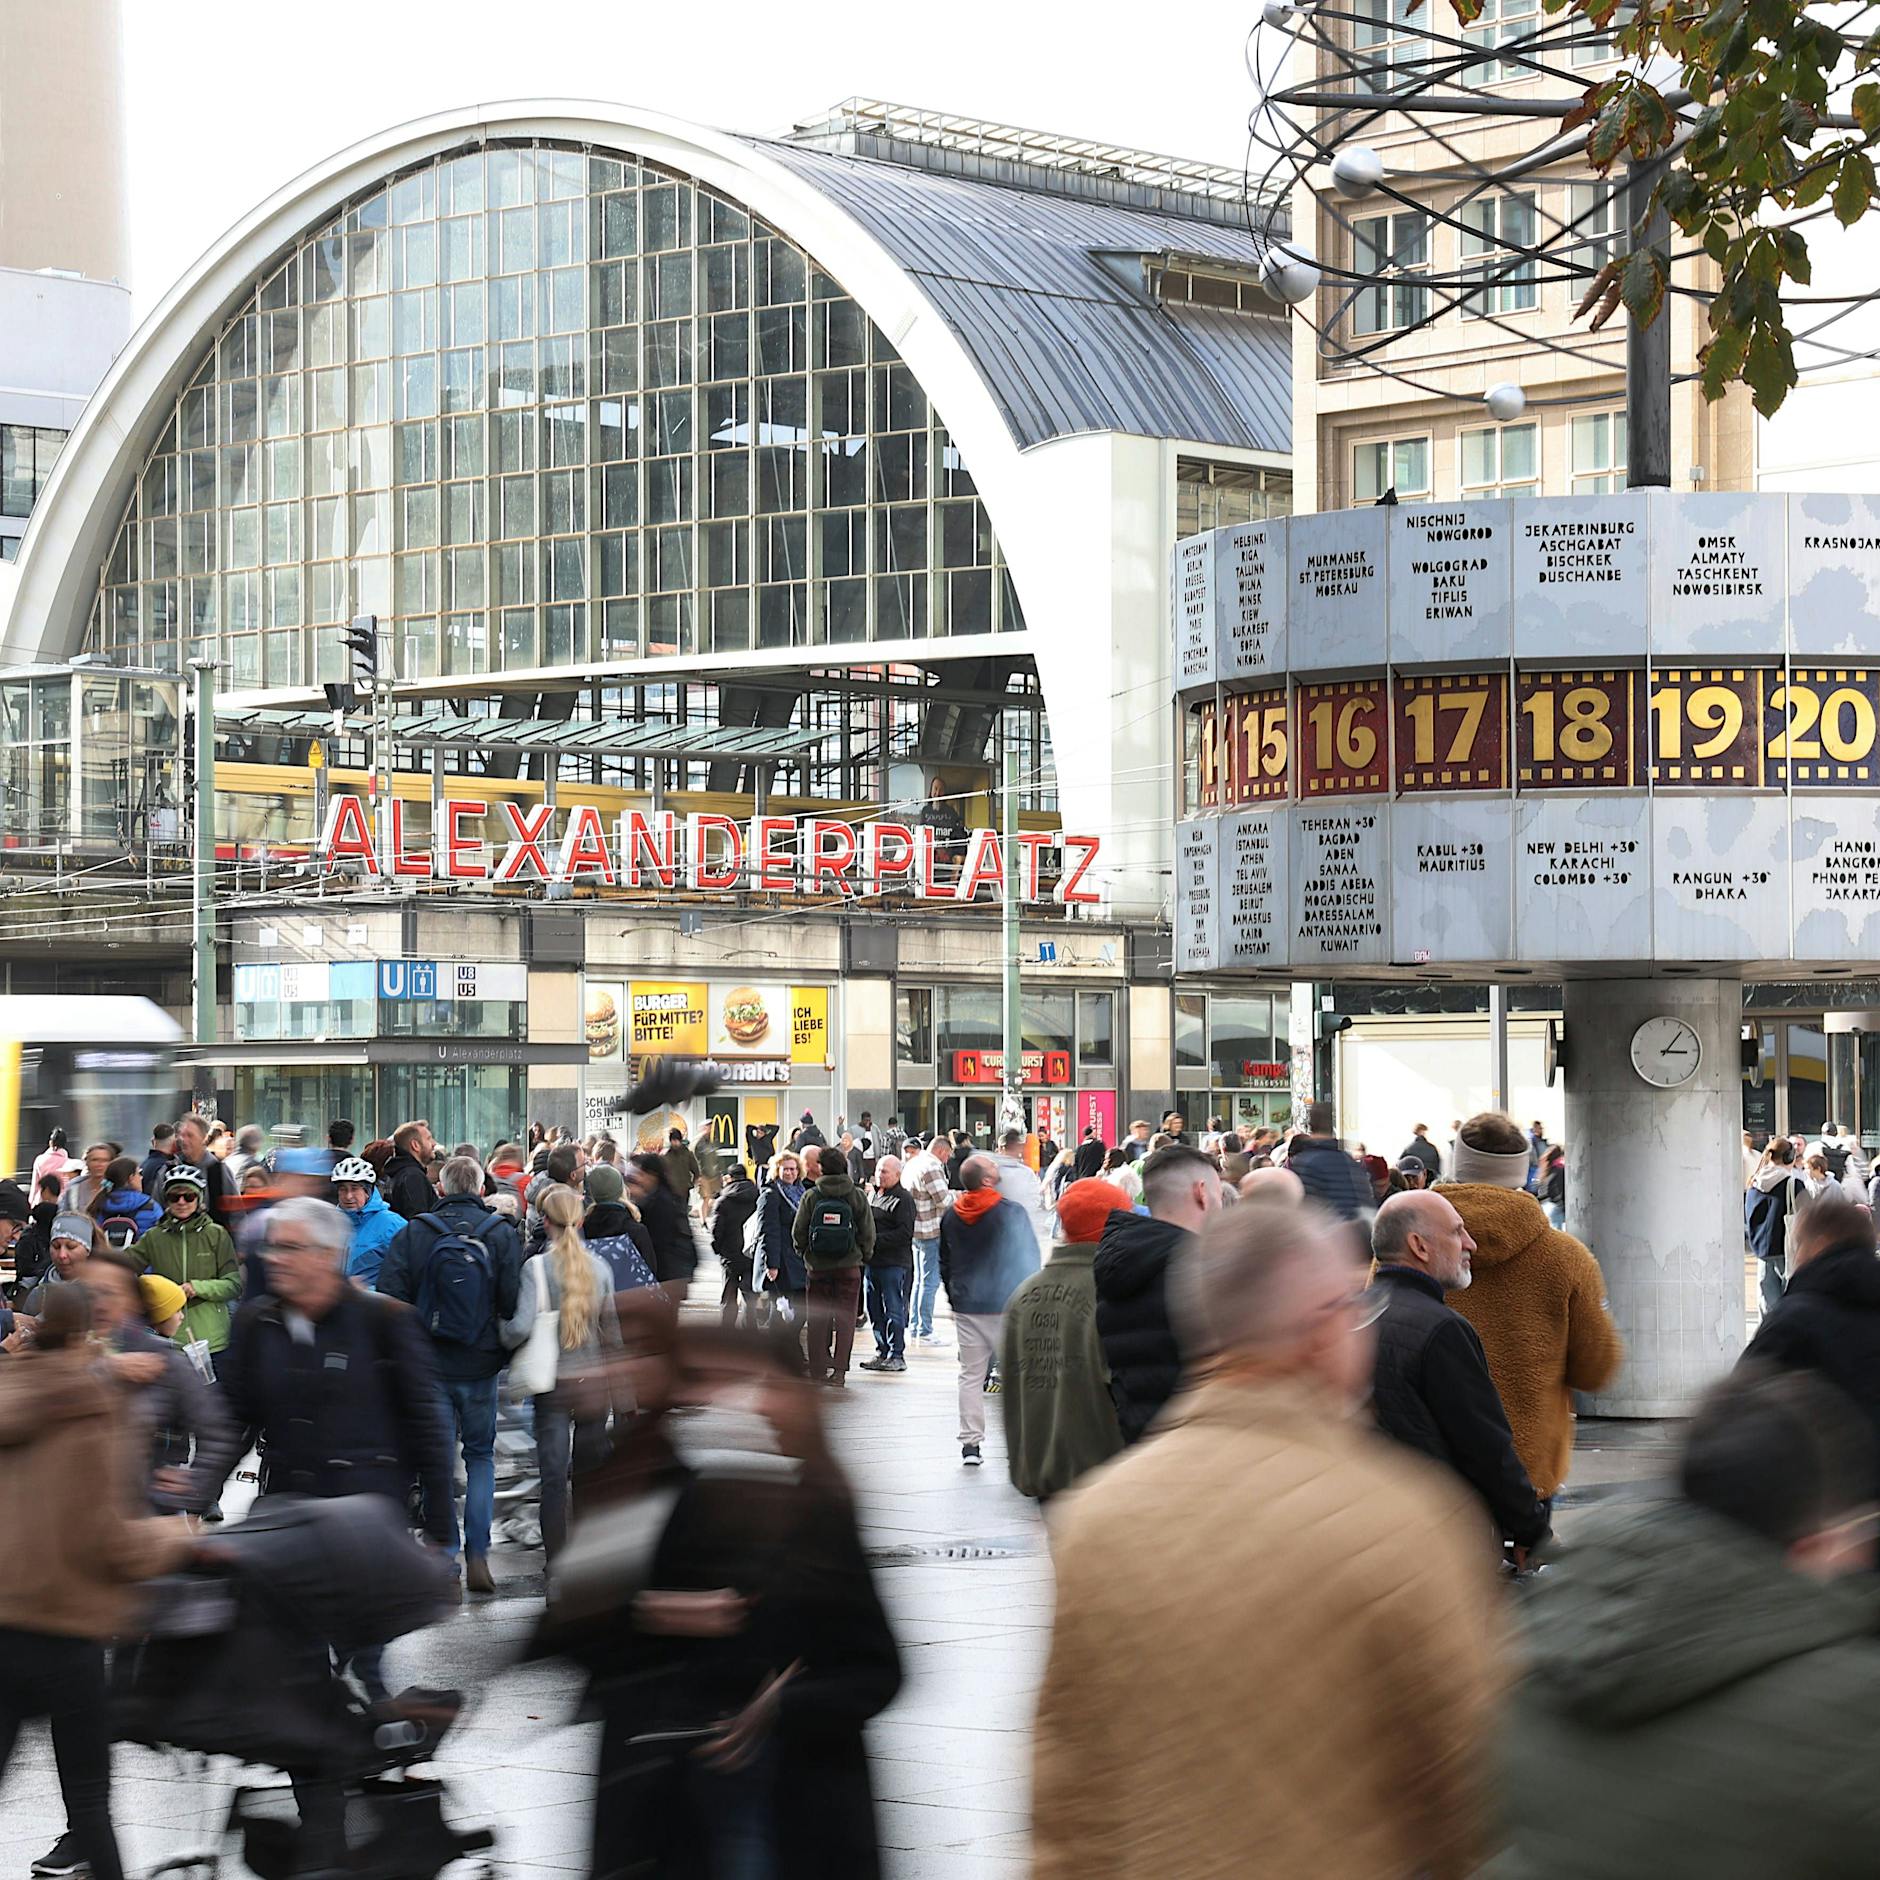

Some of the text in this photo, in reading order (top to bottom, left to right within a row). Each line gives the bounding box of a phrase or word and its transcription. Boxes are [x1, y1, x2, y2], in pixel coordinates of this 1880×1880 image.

[1407, 513, 1465, 528] NISCHNIJ
[1427, 527, 1492, 542] NOWGOROD
[1526, 522, 1634, 537] JEKATERINBURG
[1233, 533, 1267, 549] HELSINKI
[1539, 538, 1621, 552] ASCHGABAT
[1699, 537, 1735, 548] OMSK
[1242, 549, 1258, 562] RIGA
[1308, 551, 1365, 568] MURMANSK
[1547, 554, 1611, 567] BISCHKEK
[1691, 552, 1744, 564] ALMATY
[1236, 563, 1264, 578] TALLINN
[1412, 559, 1487, 574] WOLGOGRAD
[1300, 565, 1374, 584] ST. PETERSBURG
[1539, 569, 1621, 583] DUSCHANBE
[1677, 568, 1758, 579] TASCHKENT
[1239, 579, 1261, 591] WILNA
[1433, 575, 1465, 588] BAKU
[1316, 582, 1357, 597] MOSKAU
[1673, 584, 1762, 595] NOWOSIBIRSK
[1239, 593, 1261, 606] MINSK
[1431, 590, 1467, 603] TIFLIS
[1242, 609, 1258, 621] KIEW
[1426, 606, 1472, 619] ERIWAN
[1233, 622, 1269, 638] BUKAREST
[1241, 639, 1260, 652] SOFIA
[1237, 654, 1264, 666] NIKOSIA
[1405, 691, 1489, 764] 17
[1522, 687, 1613, 762] 18
[1651, 686, 1744, 759] 19
[1767, 686, 1877, 762] 20
[1309, 696, 1377, 770] 16
[1242, 707, 1287, 778] 15
[1237, 823, 1267, 835] ANKARA
[1302, 818, 1350, 831] TEHERAN
[1235, 837, 1270, 851] ISTANBUL
[1319, 833, 1360, 845] BAGDAD
[321, 794, 1102, 903] ALEXANDERPLATZ
[1417, 845, 1457, 856] KABUL
[1527, 843, 1555, 854] NEW
[1565, 842, 1603, 853] DELHI
[1834, 841, 1875, 853] HANOI
[1241, 853, 1263, 865] ATHEN
[1325, 848, 1353, 860] ADEN
[1320, 863, 1358, 876] SANAA
[1420, 859, 1485, 872] MAURITIUS
[1550, 857, 1614, 869] KARACHI
[1236, 868, 1267, 880] TEL AVIV
[1534, 873, 1595, 885] COLOMBO
[1673, 873, 1732, 884] RANGUN
[1812, 872, 1857, 884] PHNOM
[1233, 882, 1272, 896] JERUSALEM
[1304, 878, 1374, 891] ADDIS ABEBA
[1305, 893, 1374, 906] MOGADISCHU
[1696, 888, 1746, 899] DHAKA
[1240, 898, 1263, 910] BEIRUT
[1233, 912, 1271, 925] DAMASKUS
[1305, 908, 1374, 922] DARESSALAM
[1240, 927, 1263, 941] KAIRO
[1299, 924, 1381, 937] ANTANANARIVO
[1235, 942, 1270, 955] KAPSTADT
[1321, 939, 1359, 951] KUWAIT
[459, 967, 476, 979] U8
[382, 964, 404, 997] U
[459, 983, 476, 996] U5
[633, 993, 688, 1011] BURGER
[659, 1010, 704, 1025] MITTE?
[793, 1007, 811, 1019] ICH
[793, 1019, 823, 1031] LIEBE
[634, 1025, 674, 1042] BITTE!
[794, 1032, 811, 1044] ES!
[437, 1046, 523, 1060] U Alexanderplatz
[982, 1055, 1044, 1067] CURURST
[672, 1061, 790, 1081] Donald's
[585, 1107, 603, 1118] OS
